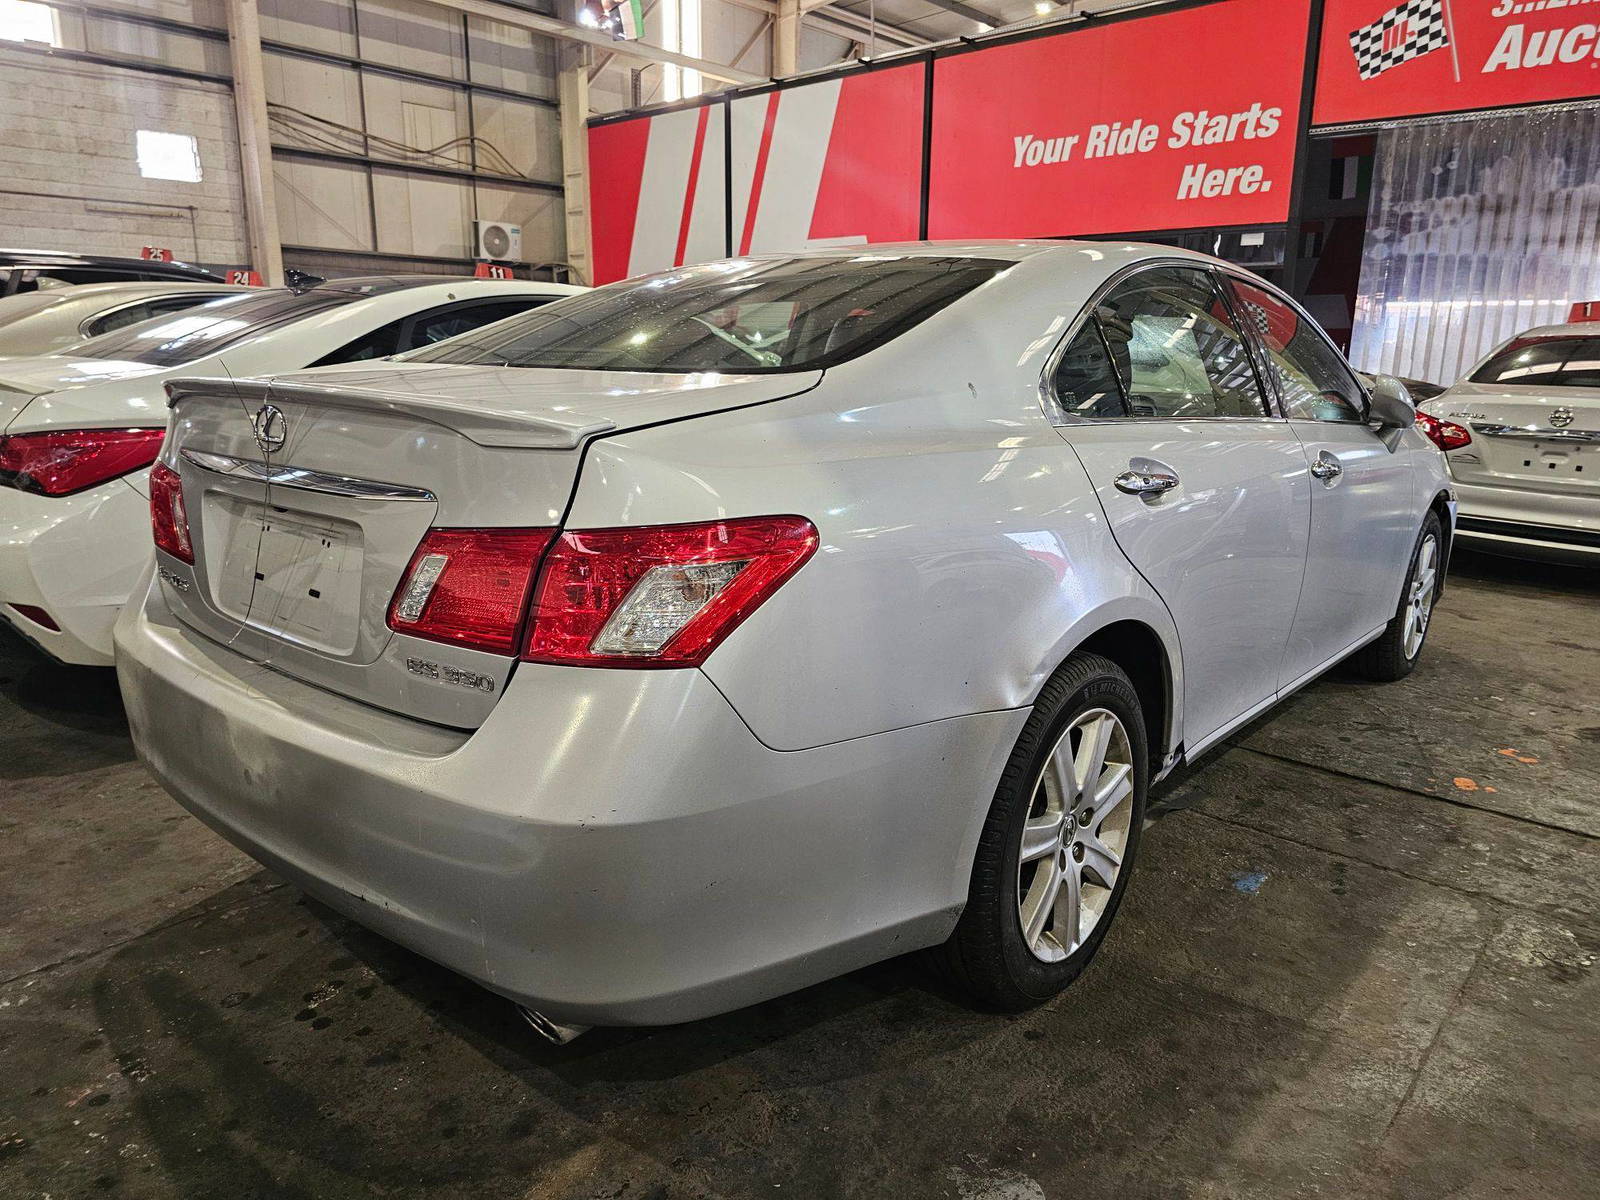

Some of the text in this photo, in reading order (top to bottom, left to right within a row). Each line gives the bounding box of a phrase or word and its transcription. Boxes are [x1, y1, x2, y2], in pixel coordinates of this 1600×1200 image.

[1013, 102, 1281, 168] Your Ride Starts
[1176, 163, 1272, 200] Here.
[150, 248, 164, 261] 25
[234, 271, 249, 287] 24
[490, 265, 505, 280] 11
[406, 656, 495, 693] ES 350
